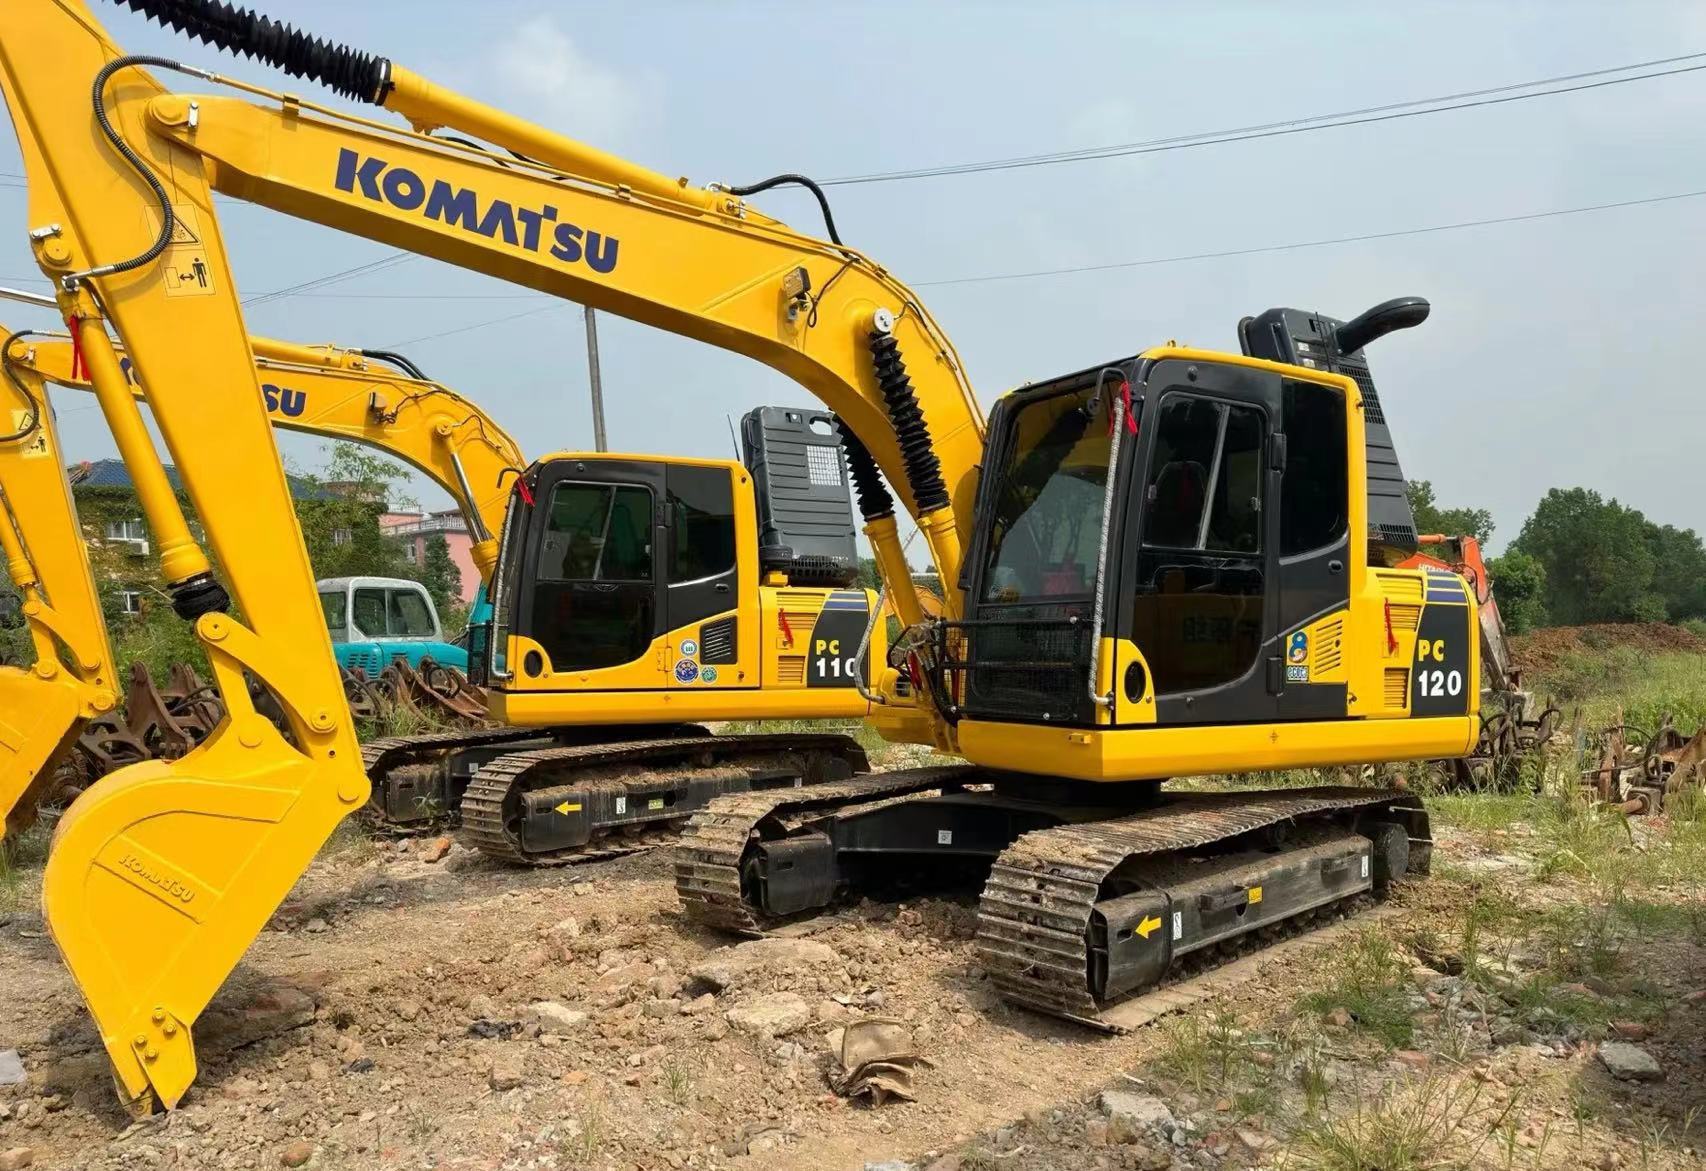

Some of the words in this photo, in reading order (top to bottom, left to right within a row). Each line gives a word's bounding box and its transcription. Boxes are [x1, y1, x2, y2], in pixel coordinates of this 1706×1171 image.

[334, 147, 619, 274] KOMATSU
[816, 639, 840, 655] PC
[1418, 639, 1445, 662] PC
[1418, 670, 1462, 697] 120
[118, 854, 195, 904] KOMATSU
